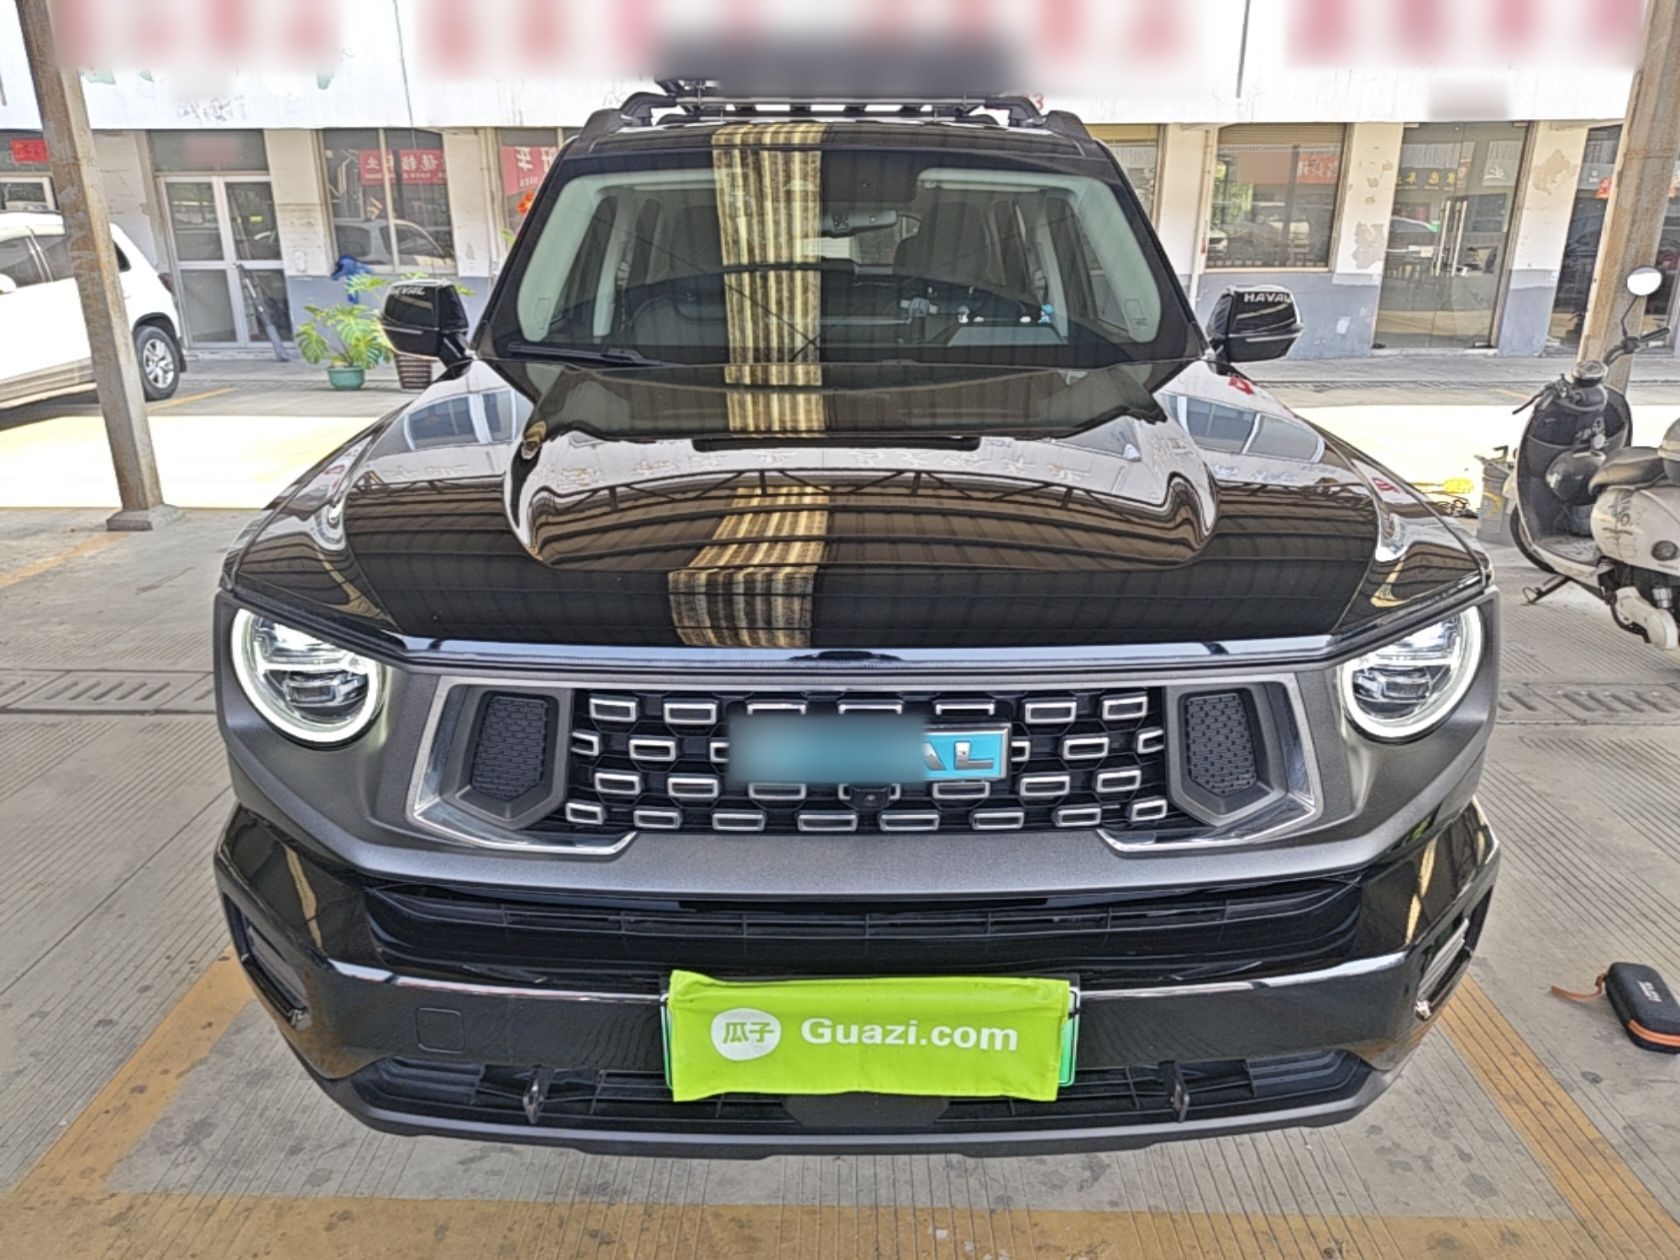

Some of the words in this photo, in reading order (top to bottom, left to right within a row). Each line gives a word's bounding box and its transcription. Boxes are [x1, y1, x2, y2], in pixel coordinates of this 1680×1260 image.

[1243, 292, 1293, 303] HAVAL
[722, 1021, 775, 1045] 瓜子
[800, 1017, 1018, 1051] Guazi.com
